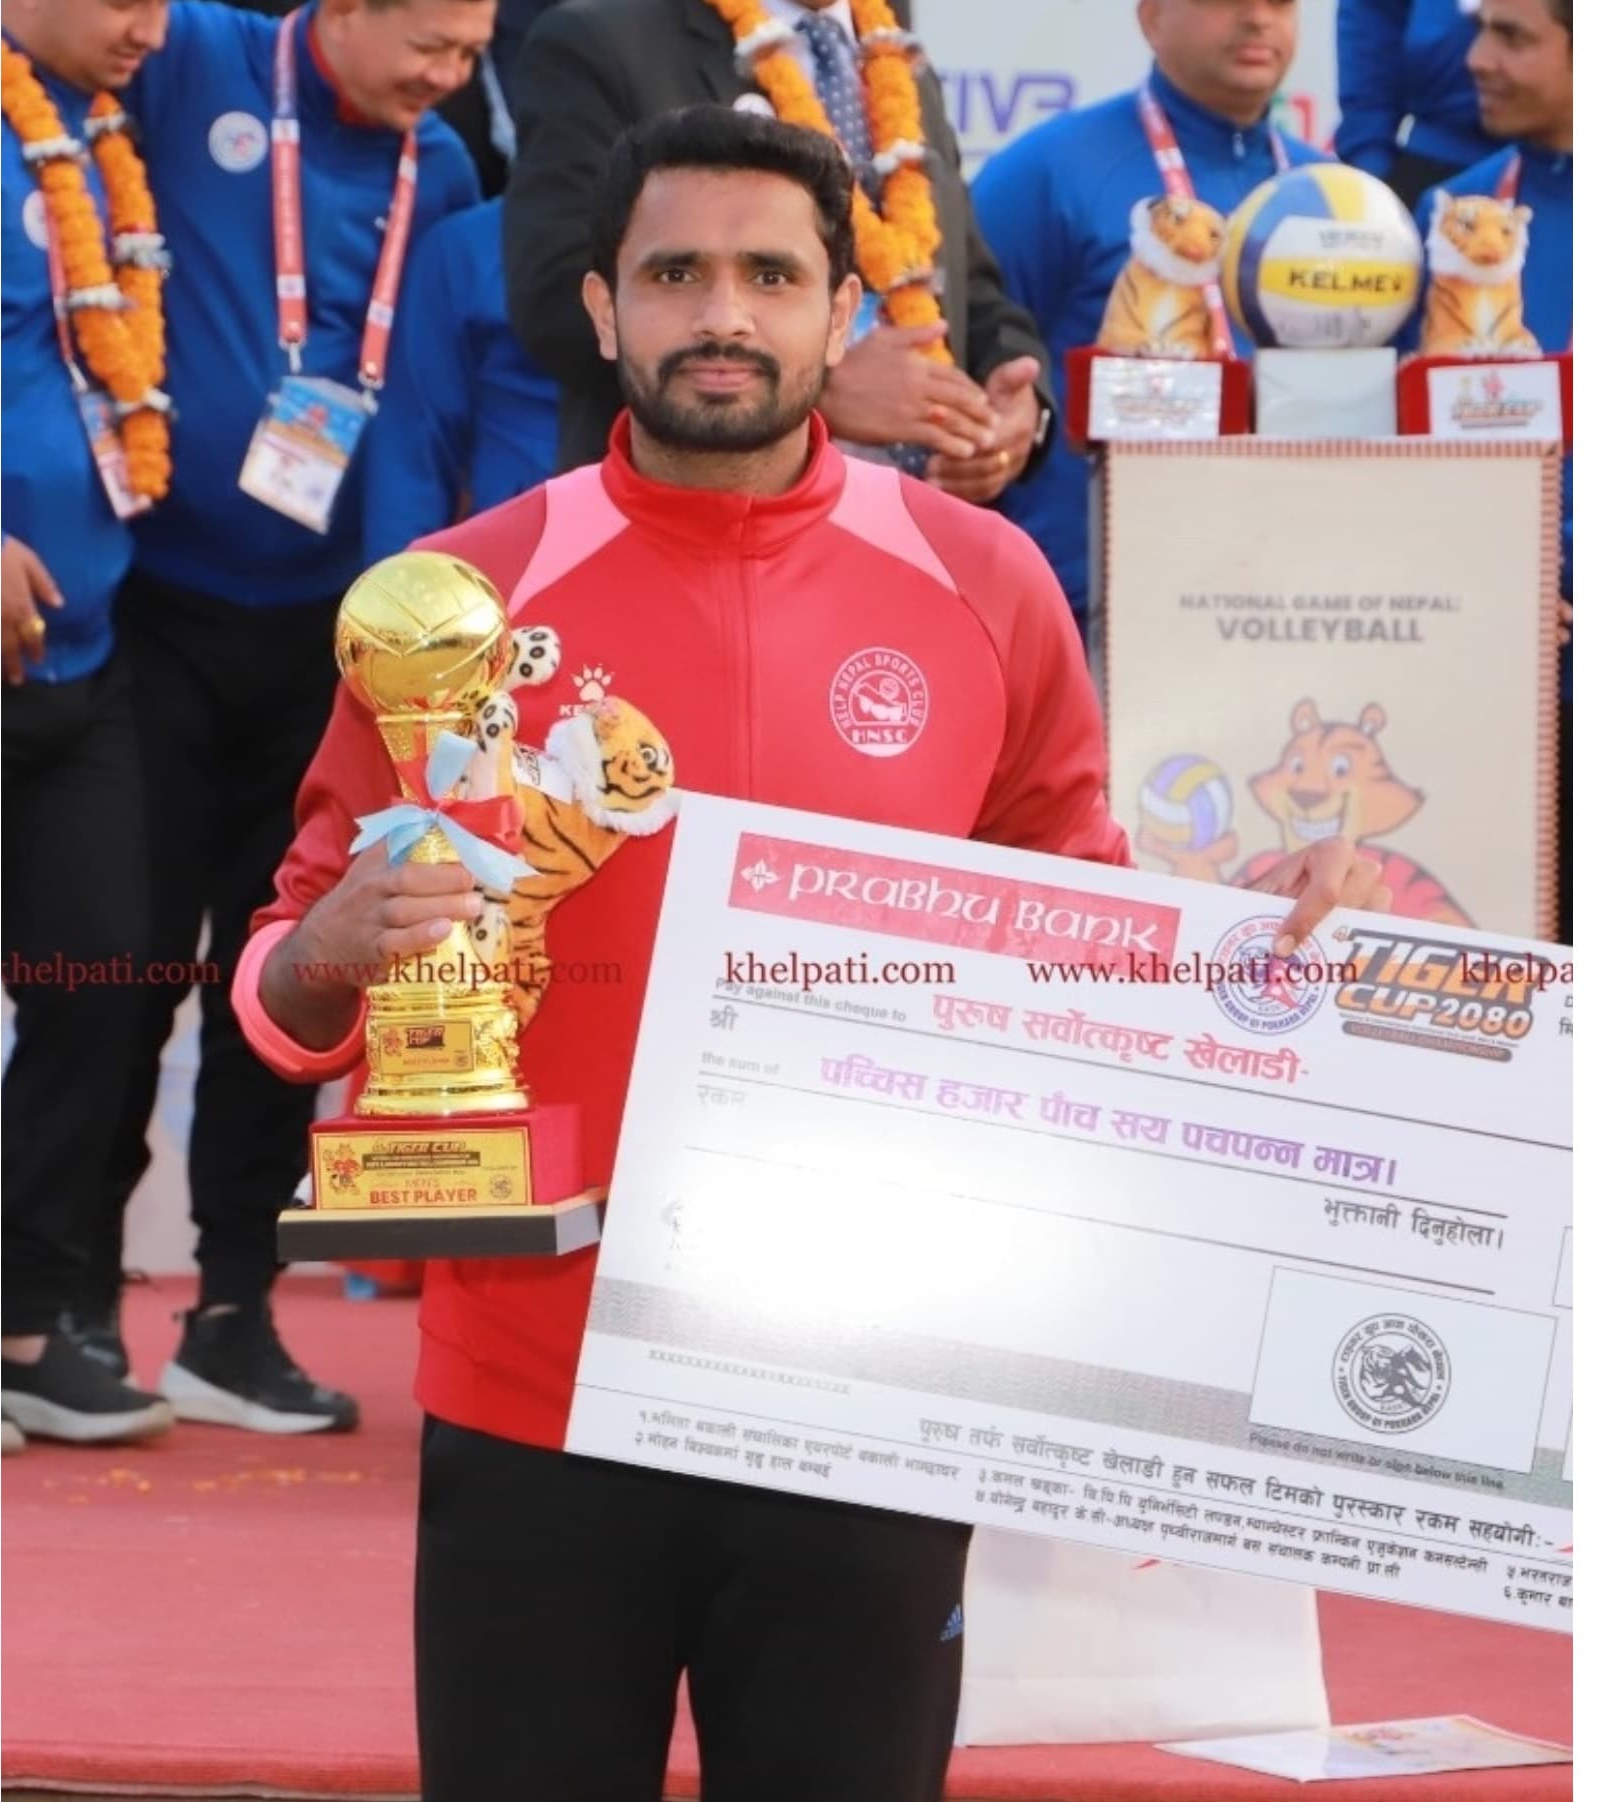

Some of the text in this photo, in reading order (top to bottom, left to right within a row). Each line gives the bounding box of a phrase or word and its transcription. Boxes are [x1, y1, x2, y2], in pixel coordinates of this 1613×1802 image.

[1179, 594, 1286, 611] NATIONAL
[1292, 595, 1352, 611] GAME
[1358, 595, 1383, 611] OF
[1217, 617, 1425, 642] VOLLEYBALL
[838, 657, 872, 690] NEPAL
[875, 653, 919, 687] SPORTS
[852, 729, 908, 744] HNSC
[1346, 934, 1541, 1005] TIGER
[710, 1007, 739, 1031] श्री
[746, 983, 801, 1005] against
[804, 992, 831, 1009] this
[835, 997, 887, 1021] cheque
[892, 1007, 907, 1023] to
[1336, 985, 1531, 1038] CUP2080
[937, 1079, 1028, 1120] हजार
[1111, 1109, 1171, 1145] सय
[1181, 1121, 1304, 1170] पचपन्न
[370, 1188, 478, 1204] BEST PLAYER
[1205, 1470, 1257, 1496] सफल
[1416, 1509, 1460, 1535] रकम
